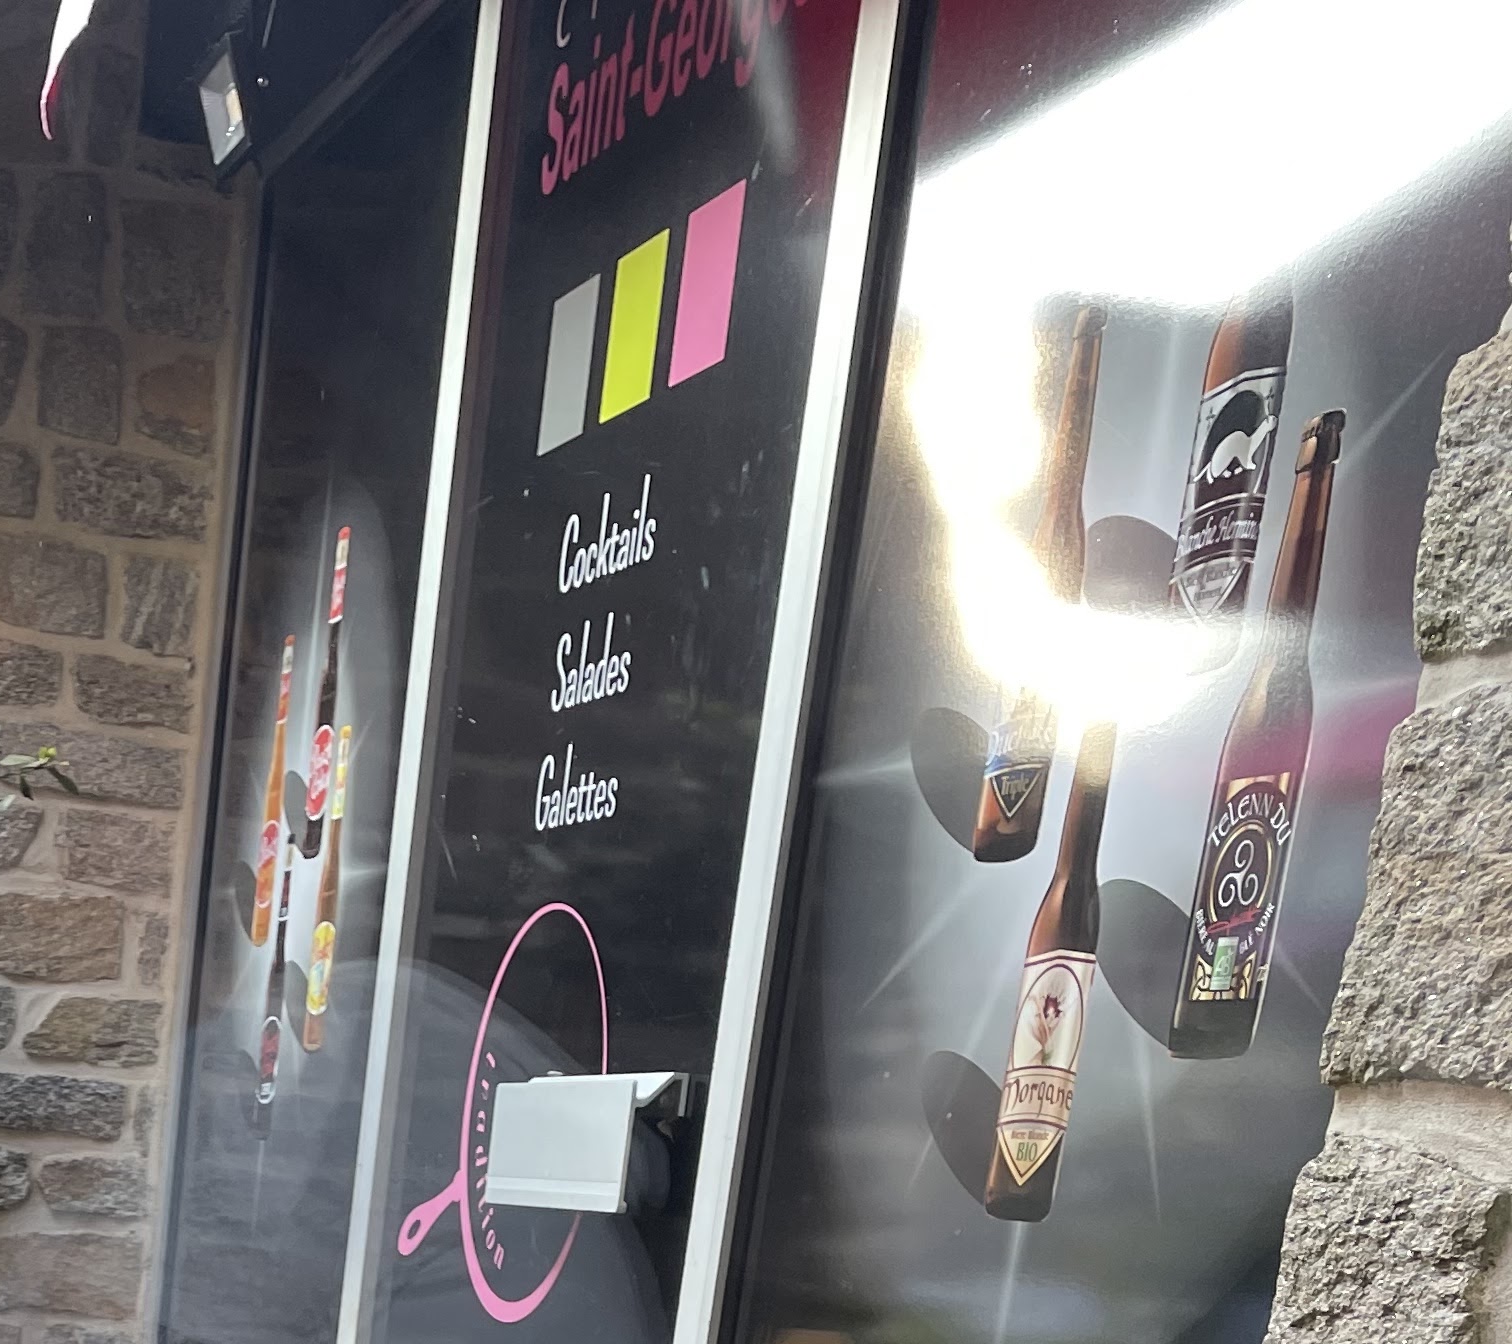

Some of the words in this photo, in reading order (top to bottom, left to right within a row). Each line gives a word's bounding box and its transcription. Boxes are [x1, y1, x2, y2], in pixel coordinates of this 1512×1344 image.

[541, 0, 807, 195] Saint-Georg
[558, 473, 657, 594] Cocktails
[551, 611, 632, 713] Salades
[534, 742, 619, 831] Galettes
[1269, 801, 1292, 846] DU
[1016, 1141, 1038, 1162] BIO
